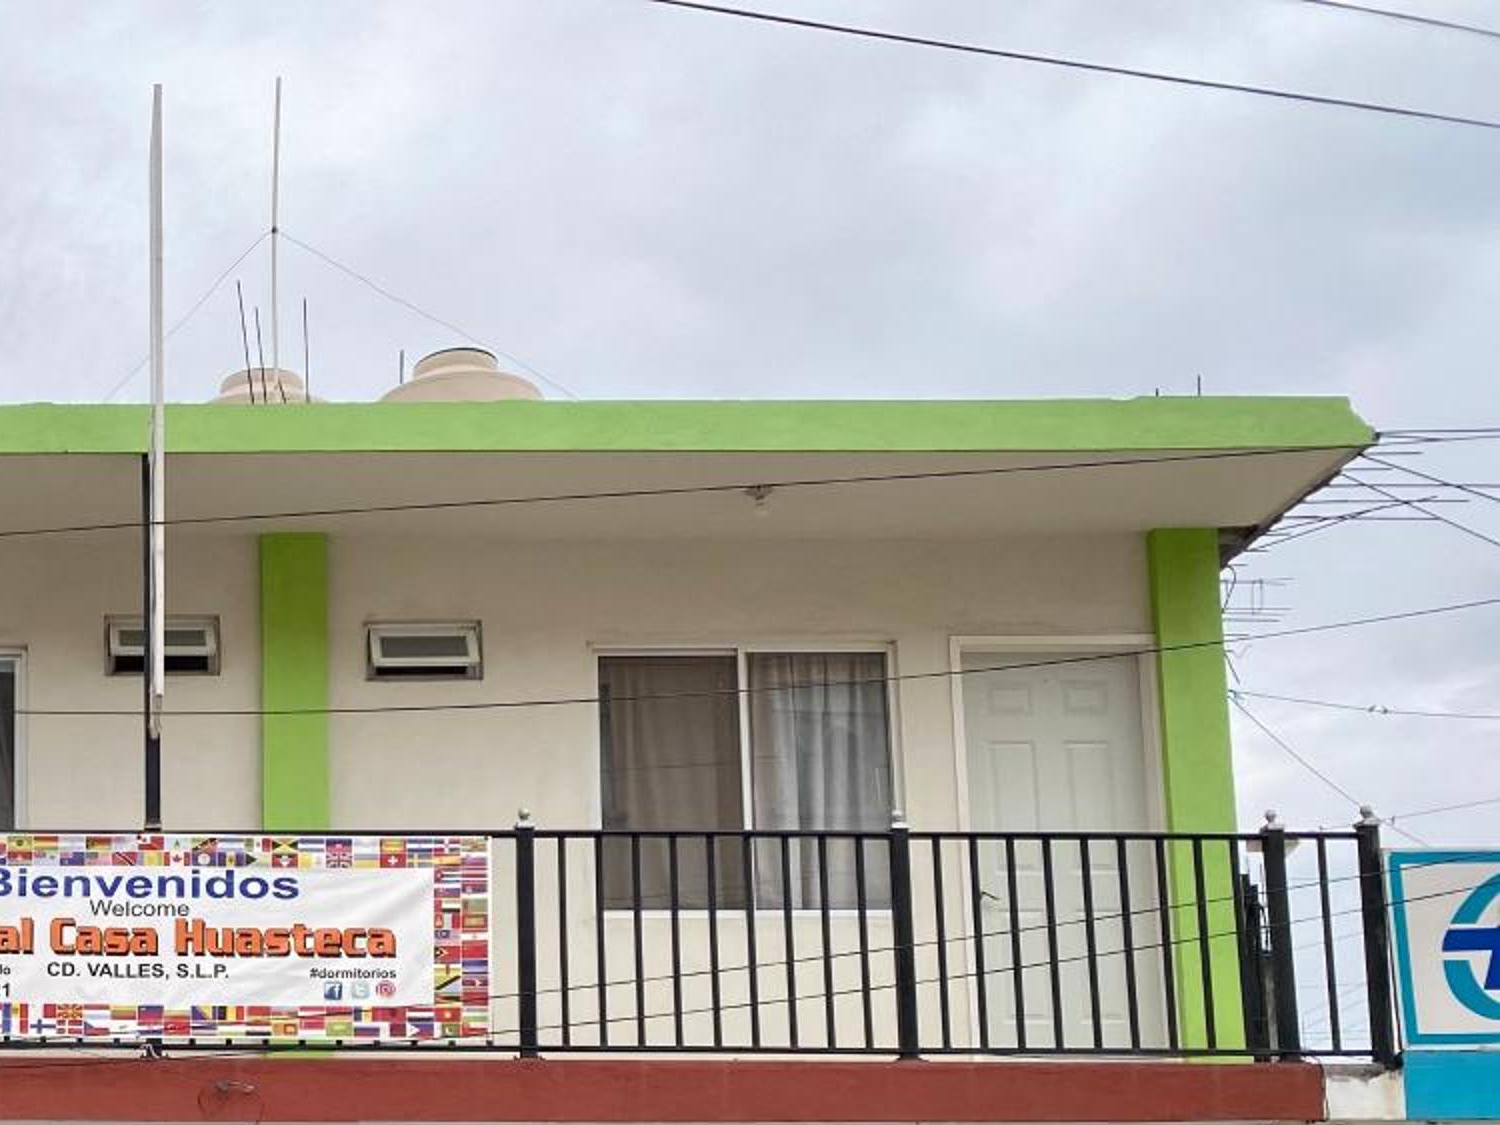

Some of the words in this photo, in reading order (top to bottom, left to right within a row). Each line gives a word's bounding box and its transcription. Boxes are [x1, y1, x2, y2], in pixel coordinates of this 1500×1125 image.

[89, 899, 190, 918] Welcome
[49, 917, 159, 957] Casa
[174, 917, 397, 958] Huasteca
[47, 961, 81, 977] CD.
[87, 962, 170, 980] VALLES,
[176, 963, 229, 978] S.L.P.
[309, 967, 397, 979] #dormitorios
